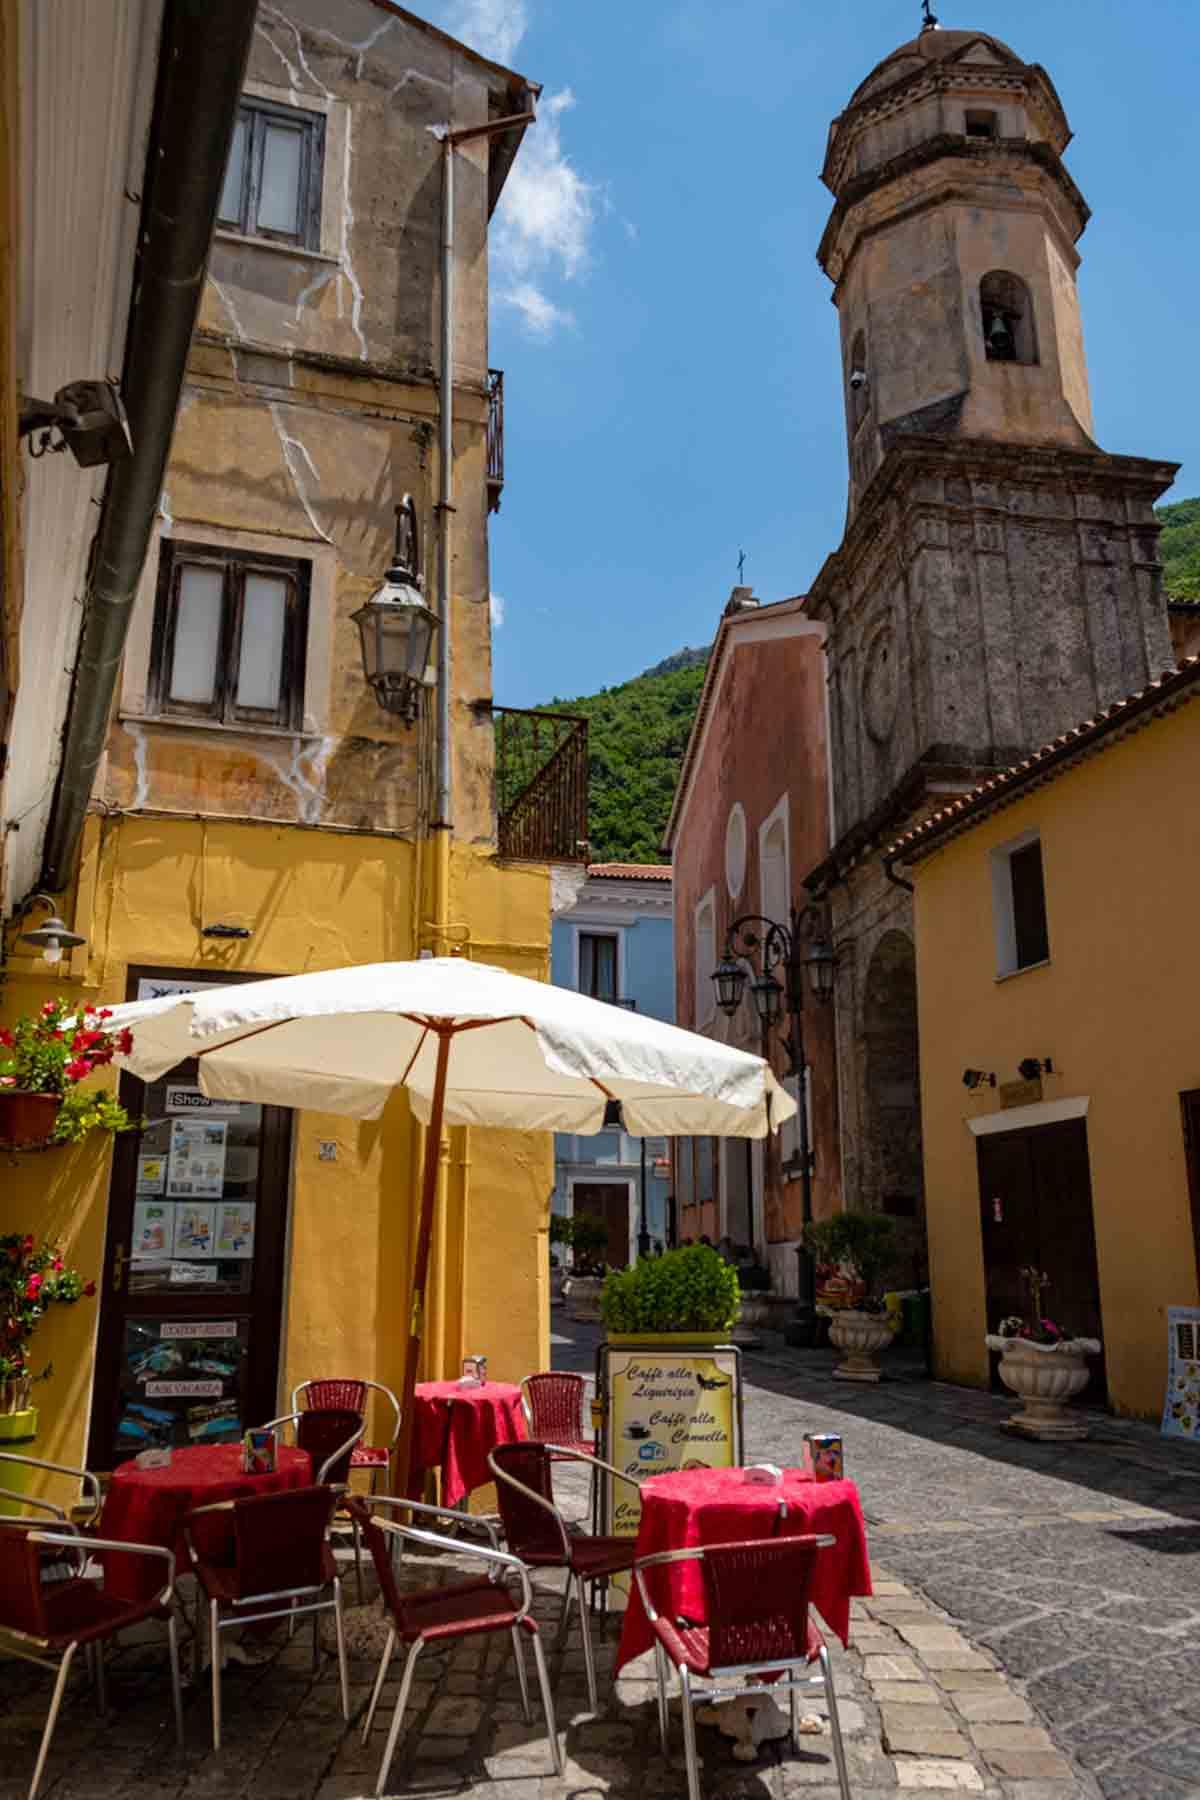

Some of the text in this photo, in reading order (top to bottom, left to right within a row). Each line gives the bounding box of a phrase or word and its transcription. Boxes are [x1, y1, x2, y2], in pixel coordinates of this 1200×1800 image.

[666, 1367, 693, 1379] alla
[632, 1384, 695, 1400] Liquirizia
[689, 1411, 716, 1424] alla
[671, 1429, 729, 1444] Cannella
